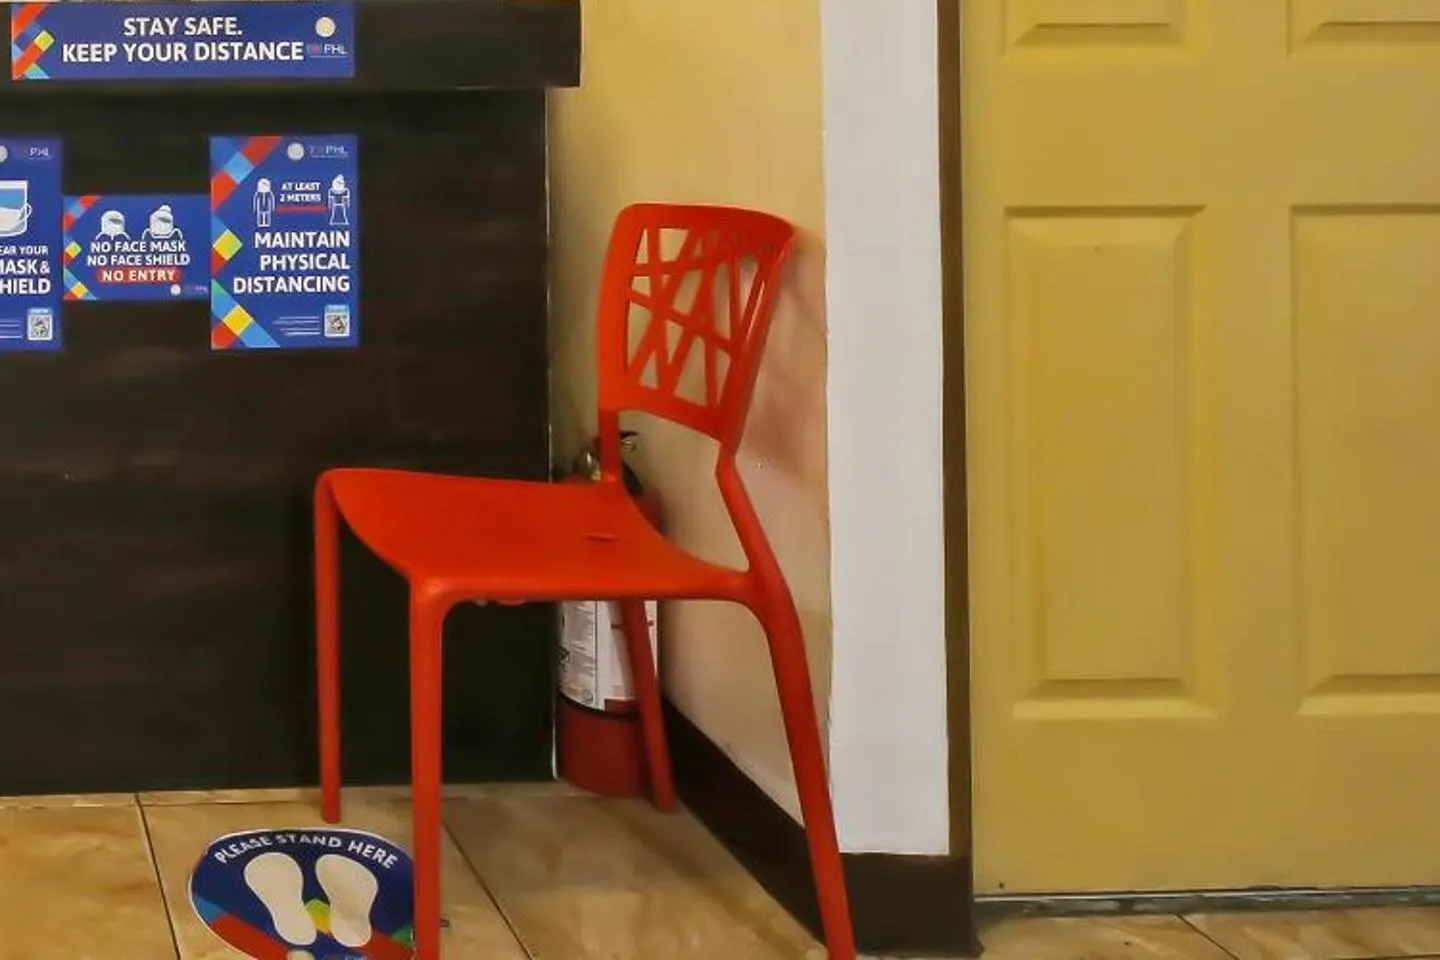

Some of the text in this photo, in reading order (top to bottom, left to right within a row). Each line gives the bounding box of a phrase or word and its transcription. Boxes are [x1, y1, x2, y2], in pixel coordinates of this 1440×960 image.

[124, 16, 242, 36] STAY SAFE.
[63, 42, 304, 62] KEEP YOUR DISTANCE
[281, 182, 320, 191] AT LEAST
[287, 194, 321, 202] METERS
[255, 231, 350, 248] MAINTAIN
[20, 246, 48, 255] YOUR
[91, 242, 186, 253] NO FACE MASK
[87, 254, 190, 266] NO FACE SHIELD
[260, 253, 350, 271] PHYSICAL
[102, 270, 175, 281] NO ENTRY
[233, 276, 350, 294] DISTANCING
[214, 834, 399, 869] PLEASE STAND HERE
